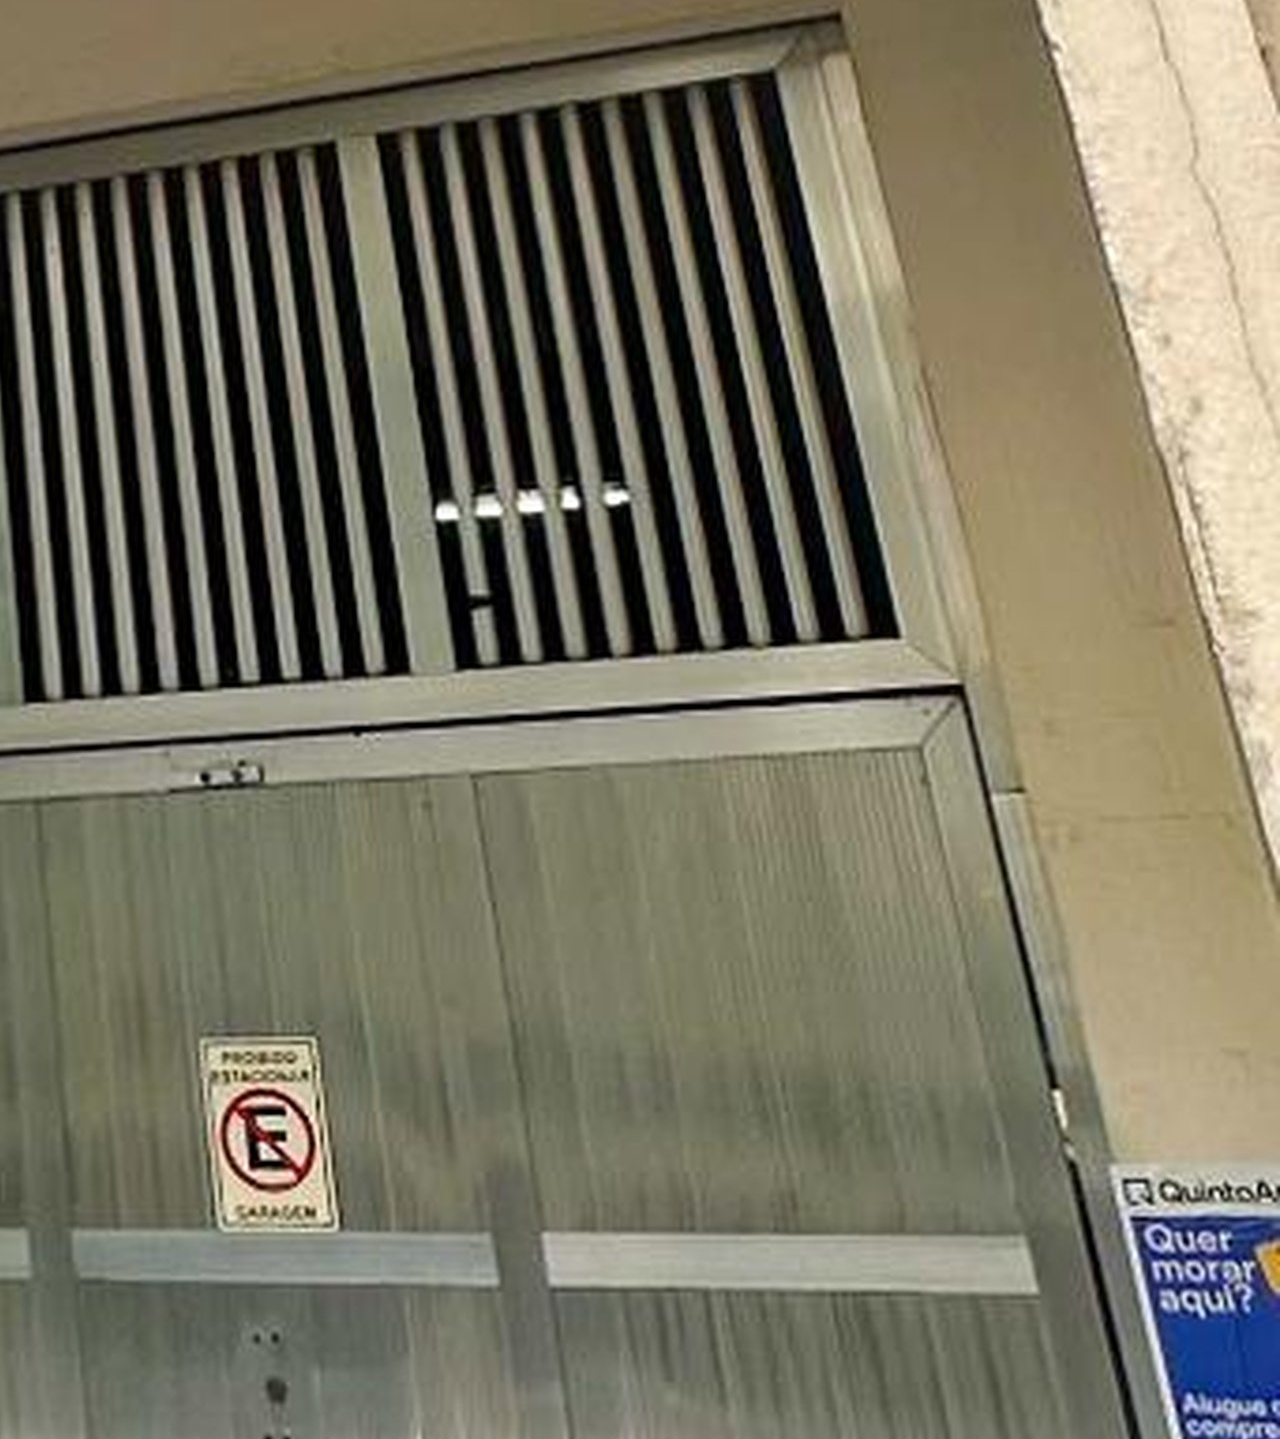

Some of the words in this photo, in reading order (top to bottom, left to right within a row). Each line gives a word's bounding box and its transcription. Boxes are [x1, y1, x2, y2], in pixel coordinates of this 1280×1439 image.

[1144, 1223, 1233, 1254] Quer
[1151, 1260, 1256, 1282] morar
[1159, 1282, 1254, 1319] aqui?
[1183, 1392, 1267, 1420] Alugue
